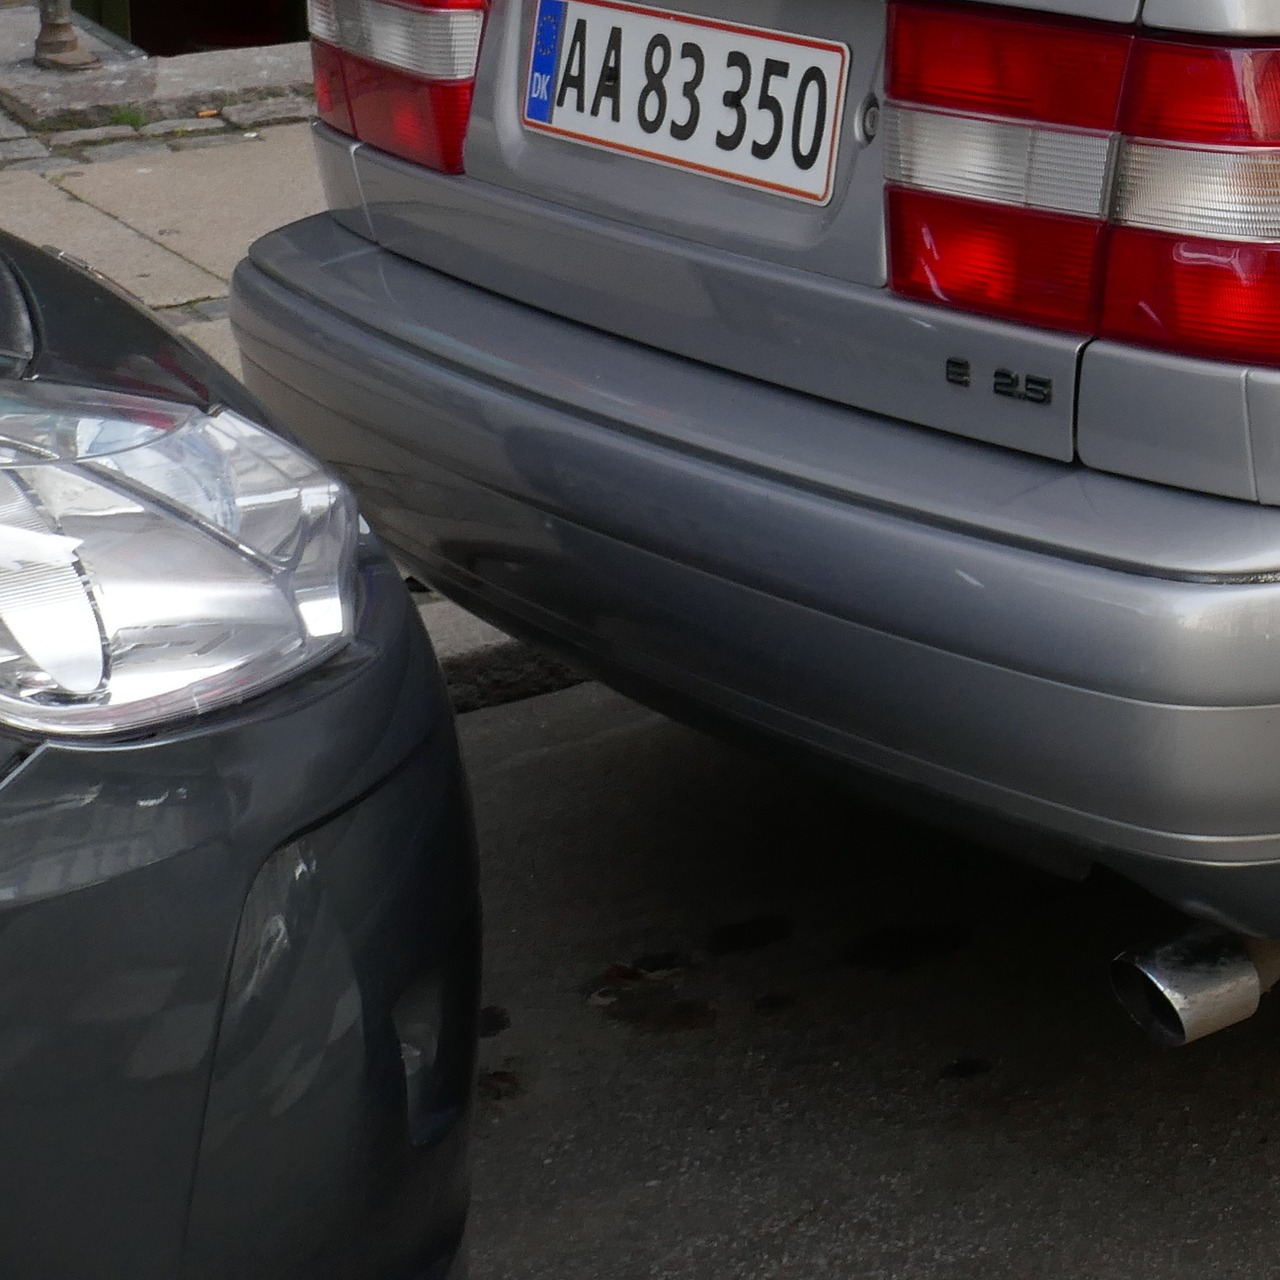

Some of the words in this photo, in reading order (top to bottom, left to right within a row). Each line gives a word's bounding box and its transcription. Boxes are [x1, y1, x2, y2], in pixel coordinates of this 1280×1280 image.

[531, 71, 550, 101] DK
[556, 18, 622, 122] AA
[637, 33, 705, 141] 83
[715, 50, 828, 171] 350
